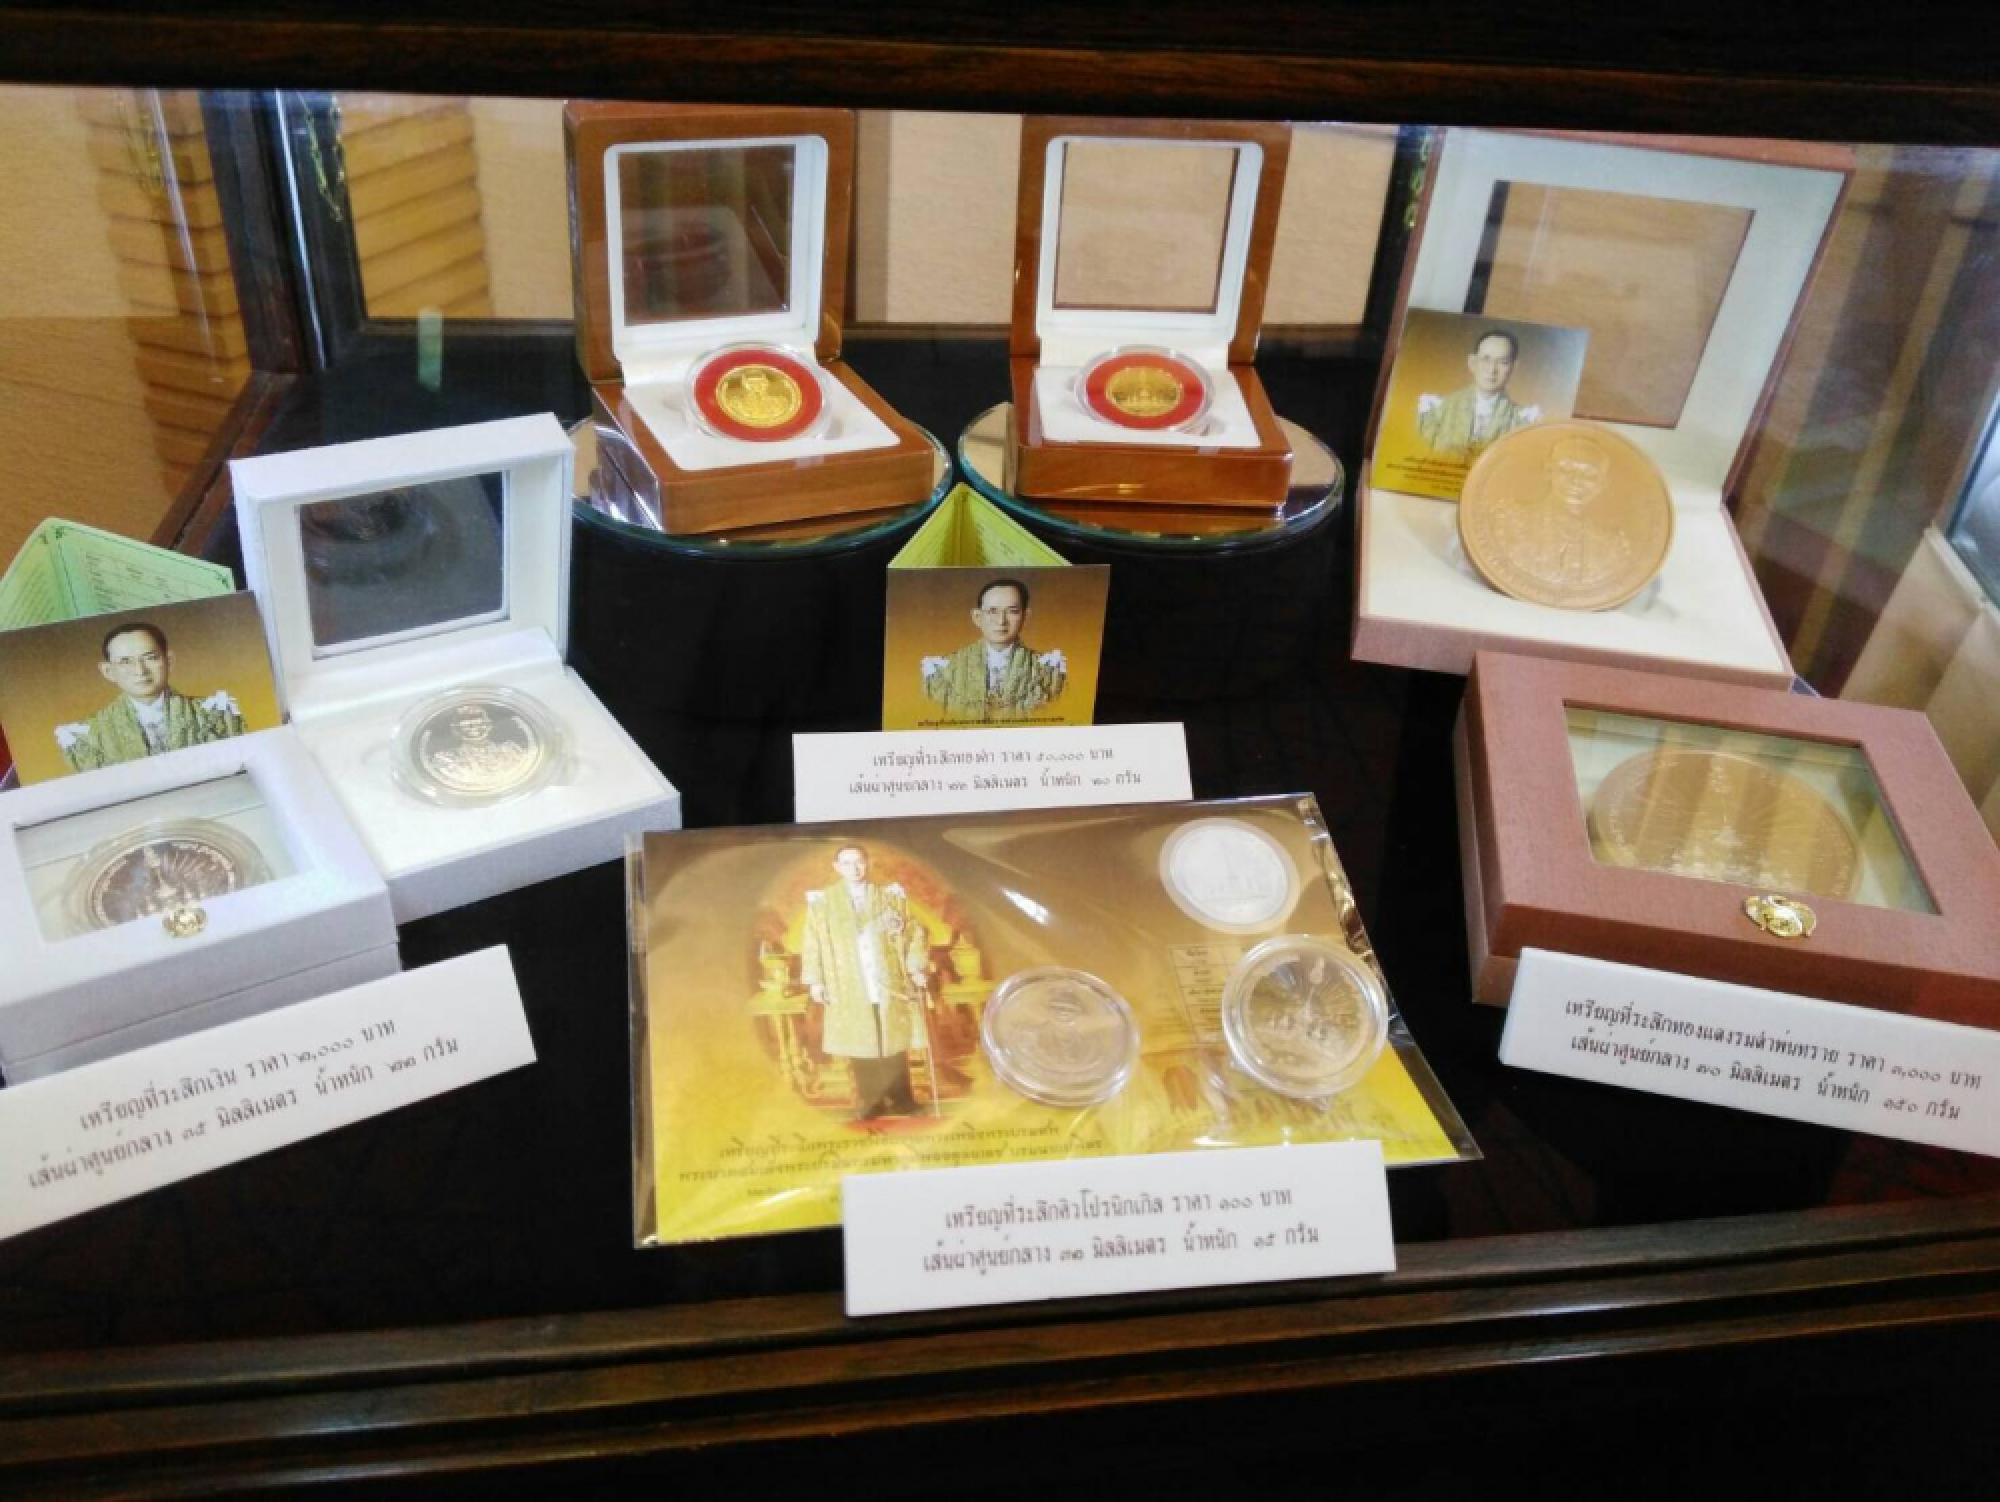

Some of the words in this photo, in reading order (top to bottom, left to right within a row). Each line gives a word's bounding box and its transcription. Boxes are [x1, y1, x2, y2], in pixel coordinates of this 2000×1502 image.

[1000, 750, 1031, 763] ราคา
[1088, 747, 1114, 760] บาท
[1039, 766, 1082, 787] น้ำหนัก
[1115, 769, 1142, 785] กรัม
[79, 1066, 238, 1131] เหรียญที่ระลึกเงิน
[244, 1051, 290, 1079] ราคา
[360, 1018, 396, 1044] บาท
[215, 1088, 298, 1129] มิลลิเมตร
[314, 1062, 376, 1096] น้ำหนัก
[422, 1035, 460, 1062] กรัม
[1728, 1059, 1802, 1092] มิลลิเมตร
[1816, 1070, 1872, 1104] น้ำหนัก
[1924, 1097, 1962, 1121] กรัม
[1847, 1050, 1887, 1073] ราคา
[1950, 1070, 1984, 1092] บาท
[1171, 1192, 1212, 1213] ราคา
[1258, 1187, 1293, 1207] บาท
[1090, 1233, 1167, 1260] มิลลิเมตร
[1181, 1219, 1239, 1254] น้ำหนัก
[1284, 1219, 1320, 1245] กรัม
